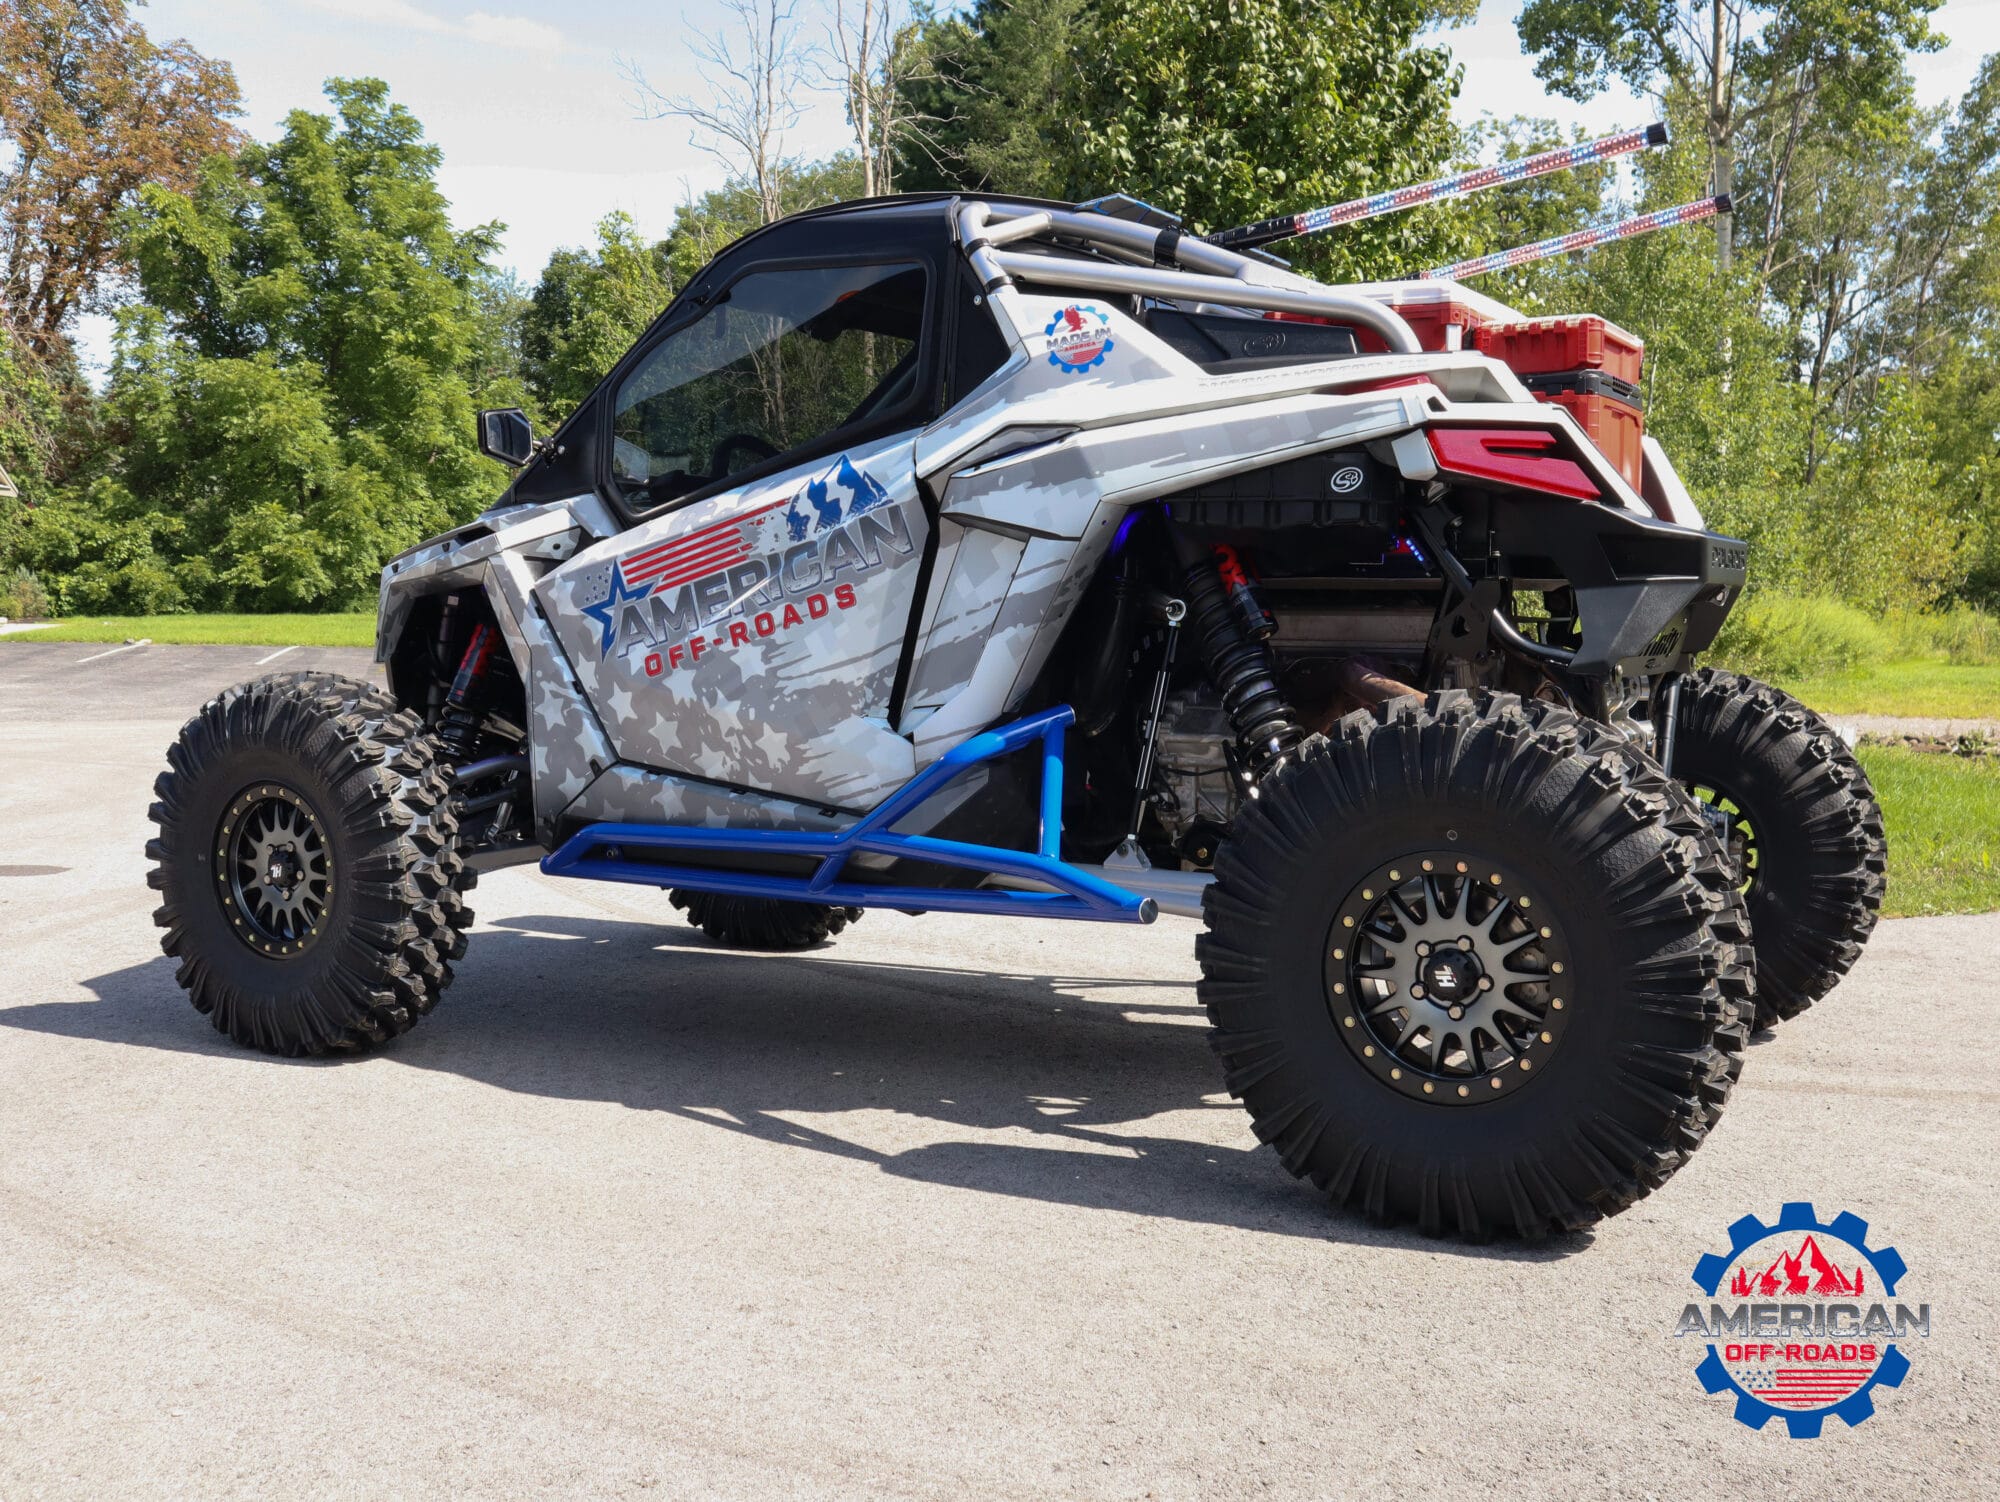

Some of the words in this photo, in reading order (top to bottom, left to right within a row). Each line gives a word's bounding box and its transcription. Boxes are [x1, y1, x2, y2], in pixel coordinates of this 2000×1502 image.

[1046, 331, 1090, 350] MADE
[1095, 327, 1112, 340] IN
[1064, 341, 1097, 352] AMERICA
[617, 505, 914, 659] AMERICAN
[645, 584, 857, 677] OFF-ROADS
